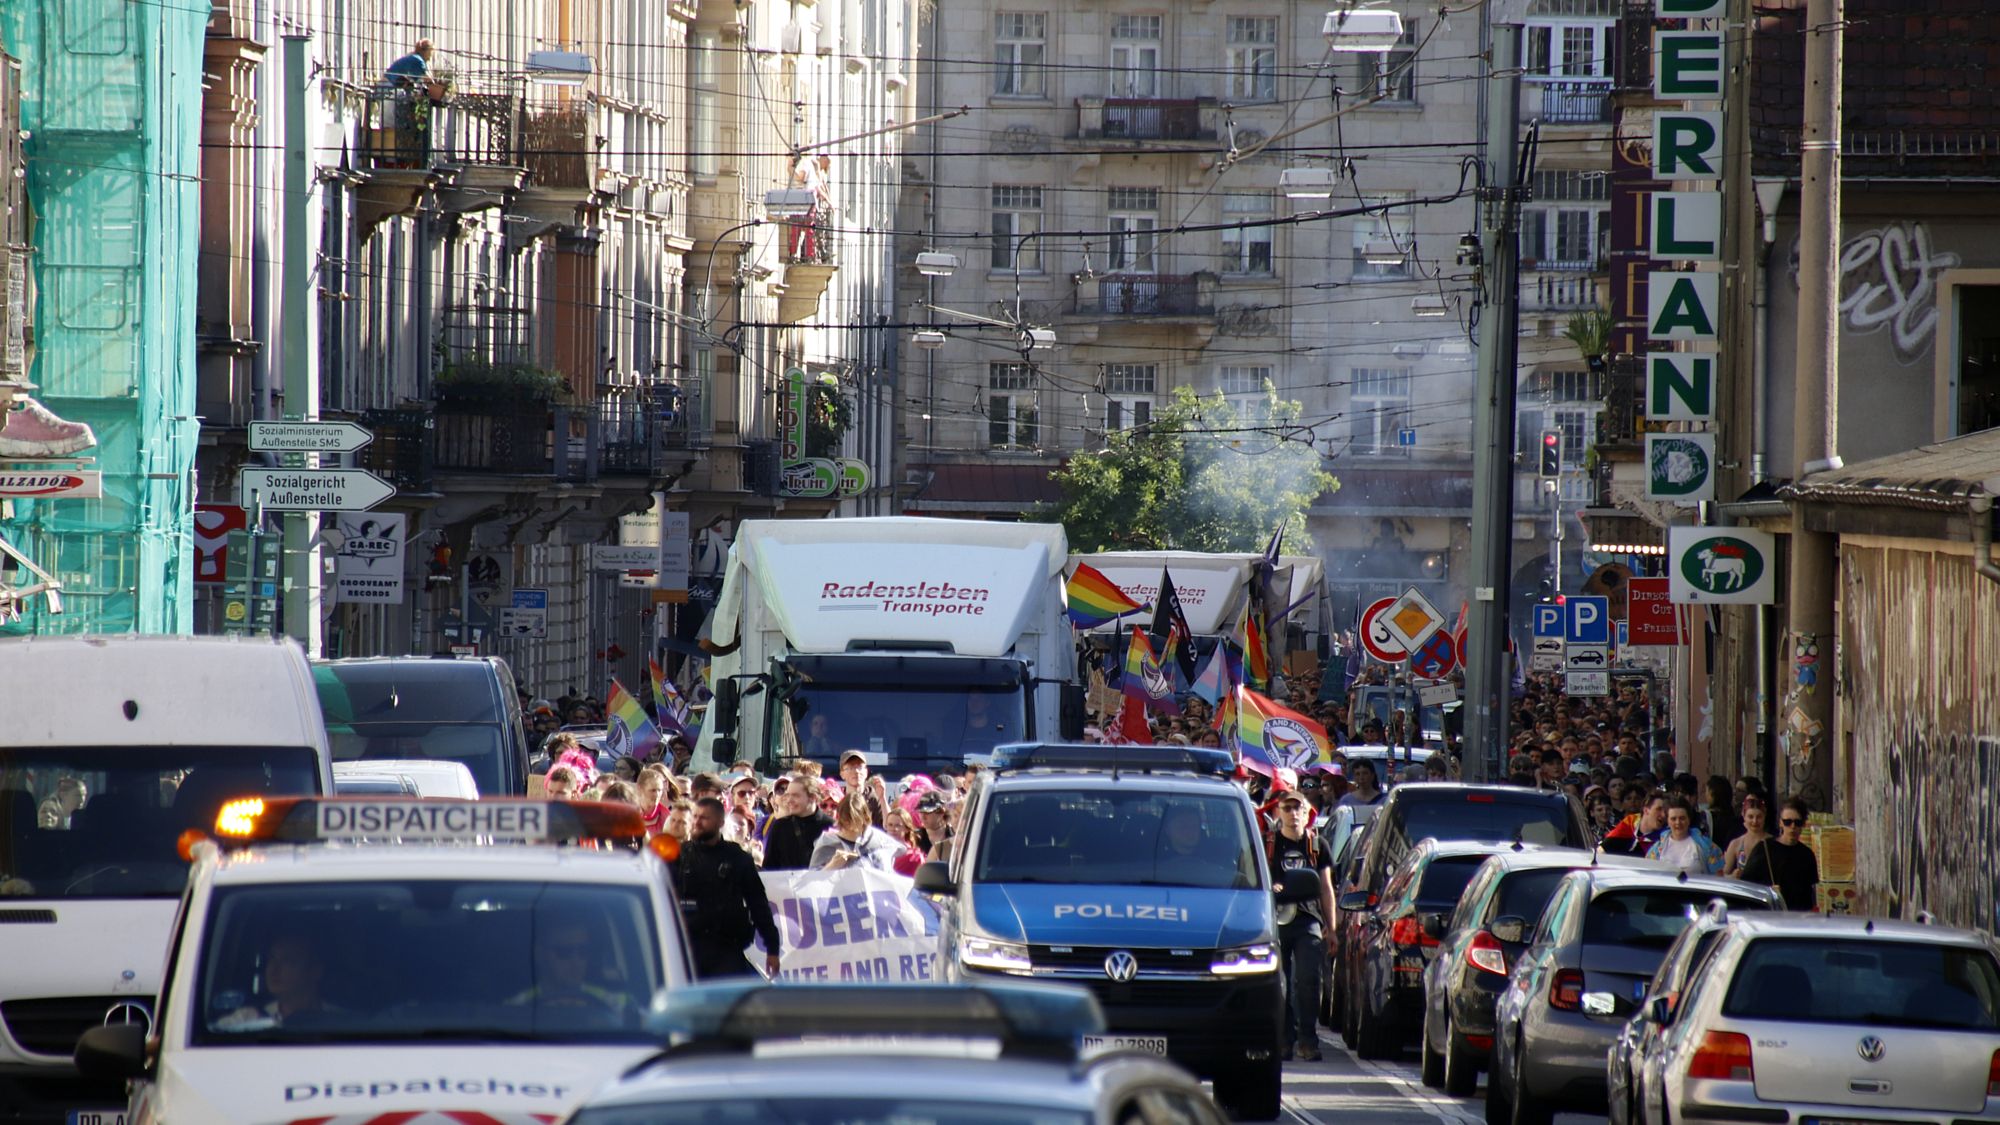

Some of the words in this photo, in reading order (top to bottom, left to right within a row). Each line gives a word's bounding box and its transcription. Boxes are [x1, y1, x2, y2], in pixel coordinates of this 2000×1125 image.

[1651, 0, 1720, 495] ERLAND
[258, 426, 343, 436] Sozialministerium
[261, 437, 317, 447] Außenstelle
[319, 438, 341, 448] SMS
[266, 475, 346, 491] Sozialgericht
[269, 491, 343, 505] Außenstelle
[340, 579, 398, 587] GROOVEAMT
[821, 581, 989, 601] Radensleben
[882, 600, 984, 616] Transporte
[1541, 609, 1558, 632] P
[1575, 603, 1598, 637] P
[323, 806, 541, 832] DISPATCHER
[1054, 904, 1188, 922] POLIZEI
[840, 957, 889, 982] AND
[284, 1077, 570, 1102] Dispatcher
